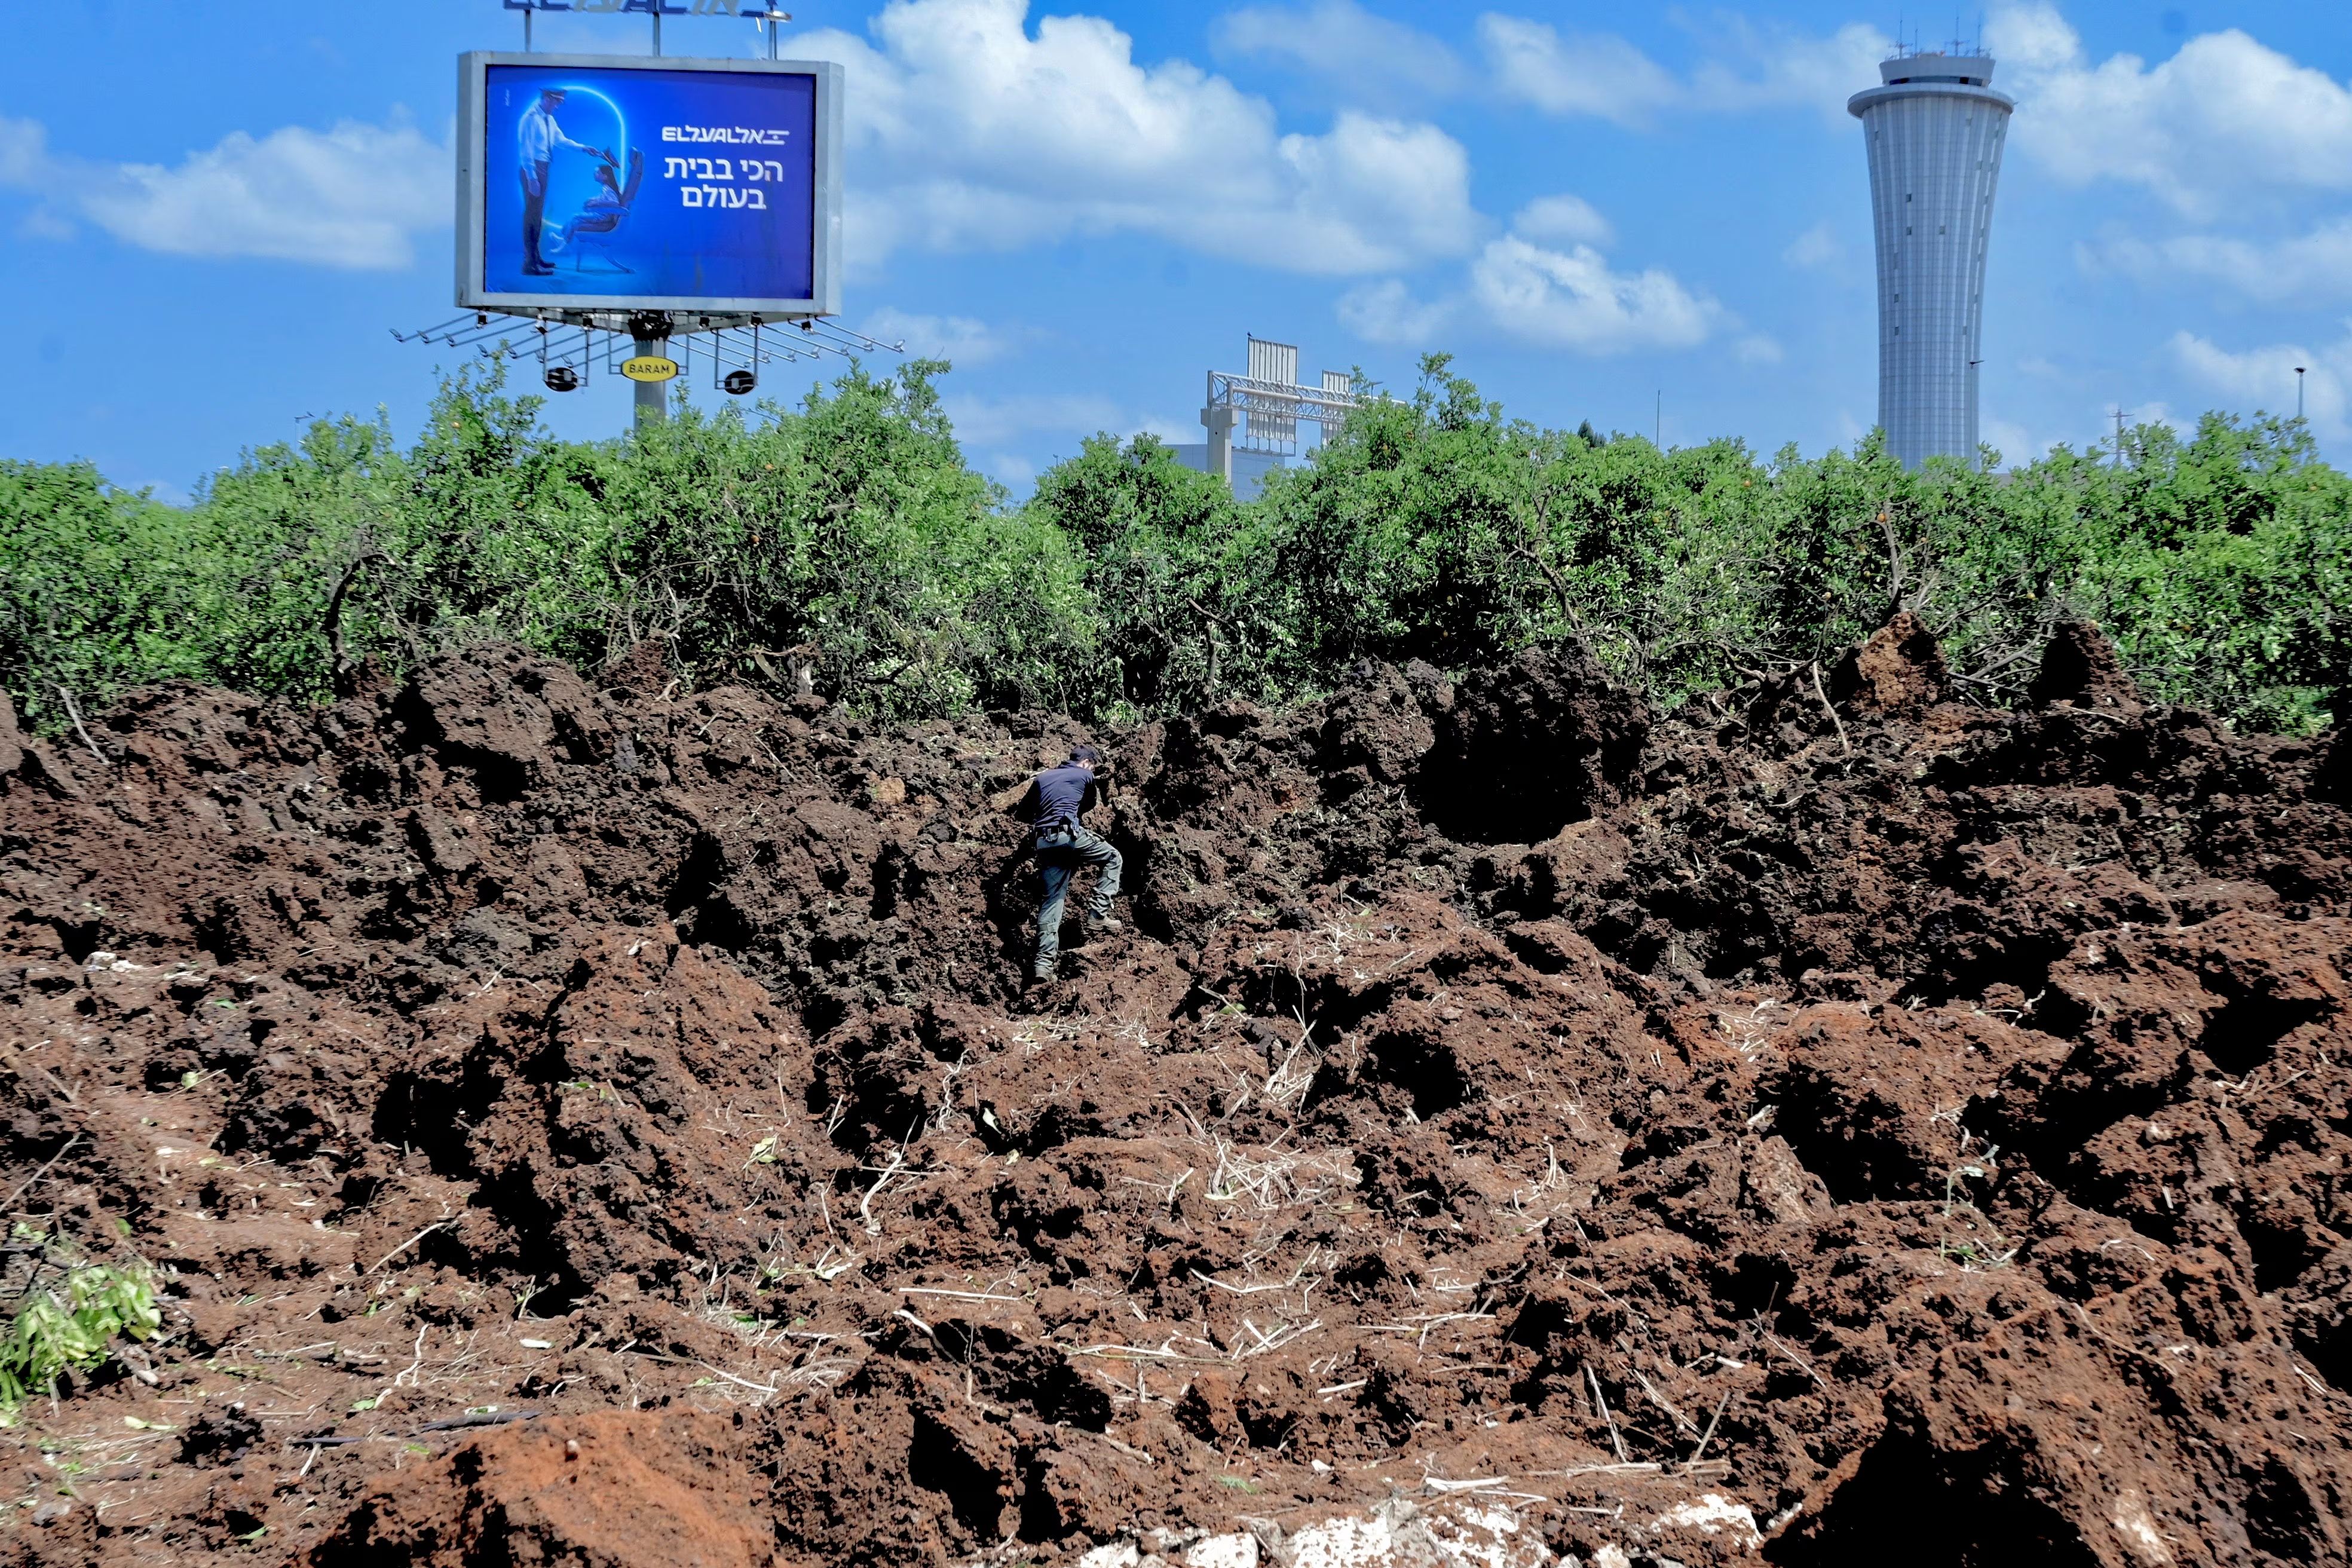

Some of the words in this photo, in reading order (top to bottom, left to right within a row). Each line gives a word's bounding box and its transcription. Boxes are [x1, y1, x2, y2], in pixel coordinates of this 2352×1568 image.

[664, 157, 734, 180] בבית
[740, 160, 783, 182] הכי
[681, 184, 767, 209] בעולם
[629, 364, 670, 373] BARAM
